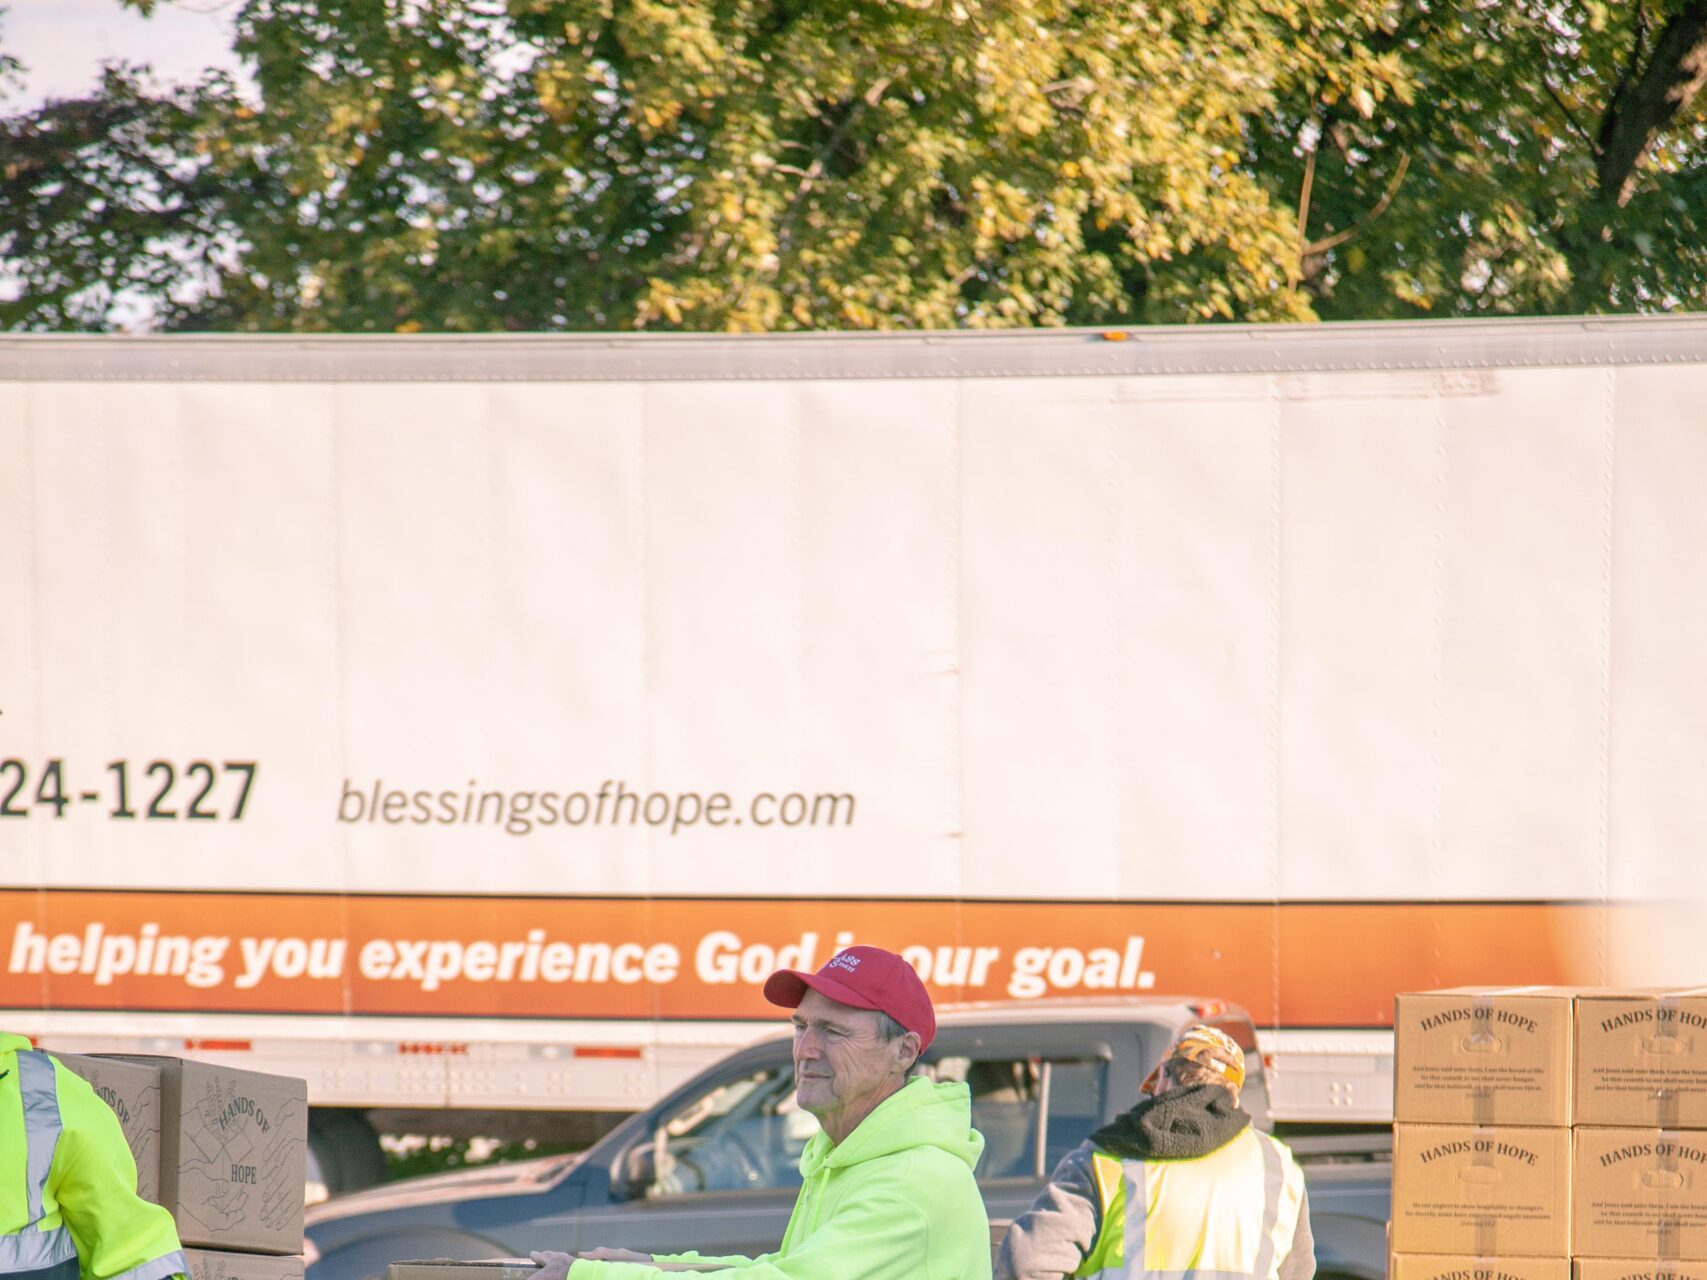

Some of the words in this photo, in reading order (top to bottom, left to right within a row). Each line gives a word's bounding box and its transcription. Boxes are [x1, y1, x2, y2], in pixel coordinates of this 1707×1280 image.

[0, 758, 257, 821] 24-1227
[336, 778, 856, 836] blessingsofhope.com
[8, 922, 229, 988] helping
[234, 937, 346, 988] you
[359, 930, 680, 990] experience
[695, 931, 818, 984] God
[1007, 937, 1156, 997] goal.
[1420, 1008, 1471, 1032] HANDS
[1475, 1008, 1494, 1020] OF
[1497, 1010, 1538, 1034] HOPE
[1601, 1009, 1654, 1033] HANDS
[1657, 1009, 1675, 1022] OF
[98, 1086, 116, 1107] NDS
[117, 1099, 129, 1125] OF
[218, 1097, 255, 1130] HANDS
[256, 1109, 270, 1134] OF
[1420, 1141, 1471, 1164] HANDS
[1475, 1140, 1493, 1152] OF
[1497, 1143, 1538, 1166] HOPE
[1600, 1144, 1651, 1167] HANDS
[1655, 1144, 1675, 1155] OF
[231, 1164, 256, 1185] HOPE
[1474, 1270, 1493, 1280] OF
